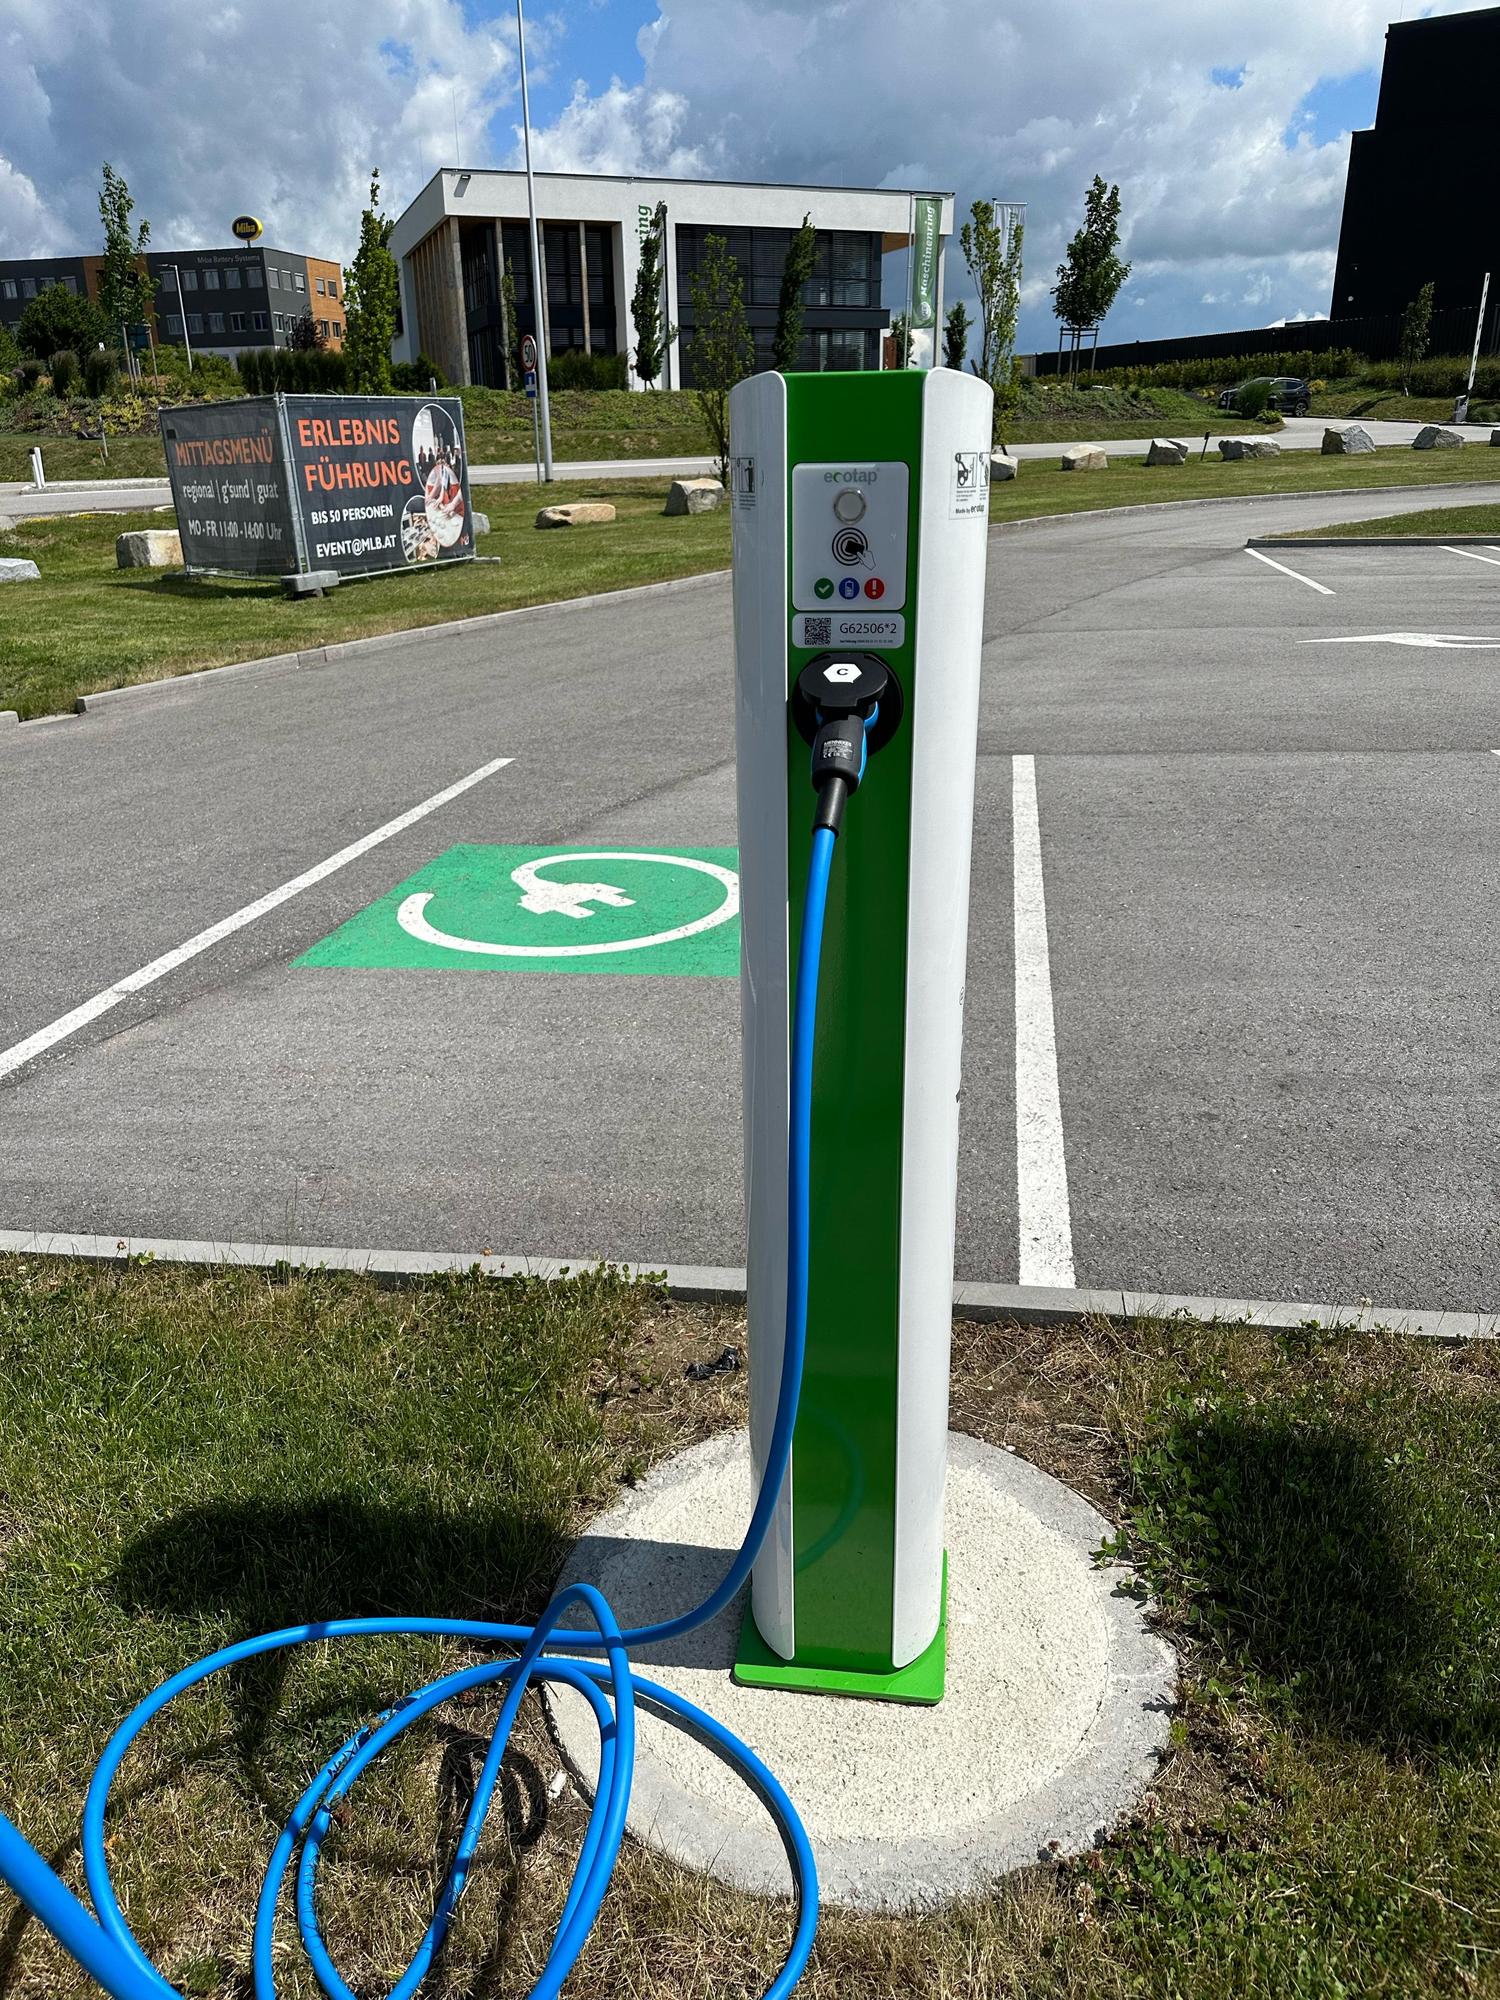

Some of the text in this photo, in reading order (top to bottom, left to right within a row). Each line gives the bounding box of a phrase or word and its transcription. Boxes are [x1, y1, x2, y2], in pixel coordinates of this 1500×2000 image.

[236, 222, 256, 234] Miba
[920, 205, 937, 297] Maschinenring
[524, 344, 533, 363] 50
[297, 418, 401, 447] ERLEBNIS
[175, 427, 273, 467] MITTAGSMENÜ
[304, 455, 412, 492] FÜHRUNG
[823, 468, 878, 486] ecotap
[183, 480, 215, 504] regional
[257, 482, 279, 505] guat
[311, 504, 394, 525] BIS 50 PERSONEN
[188, 520, 202, 537] MO
[206, 520, 219, 537] FR
[219, 520, 239, 538] 11:00
[243, 521, 265, 540] 14:00
[266, 522, 283, 541] Uhr
[316, 534, 397, 558] EVENT@MLB.AT
[836, 668, 849, 676] C
